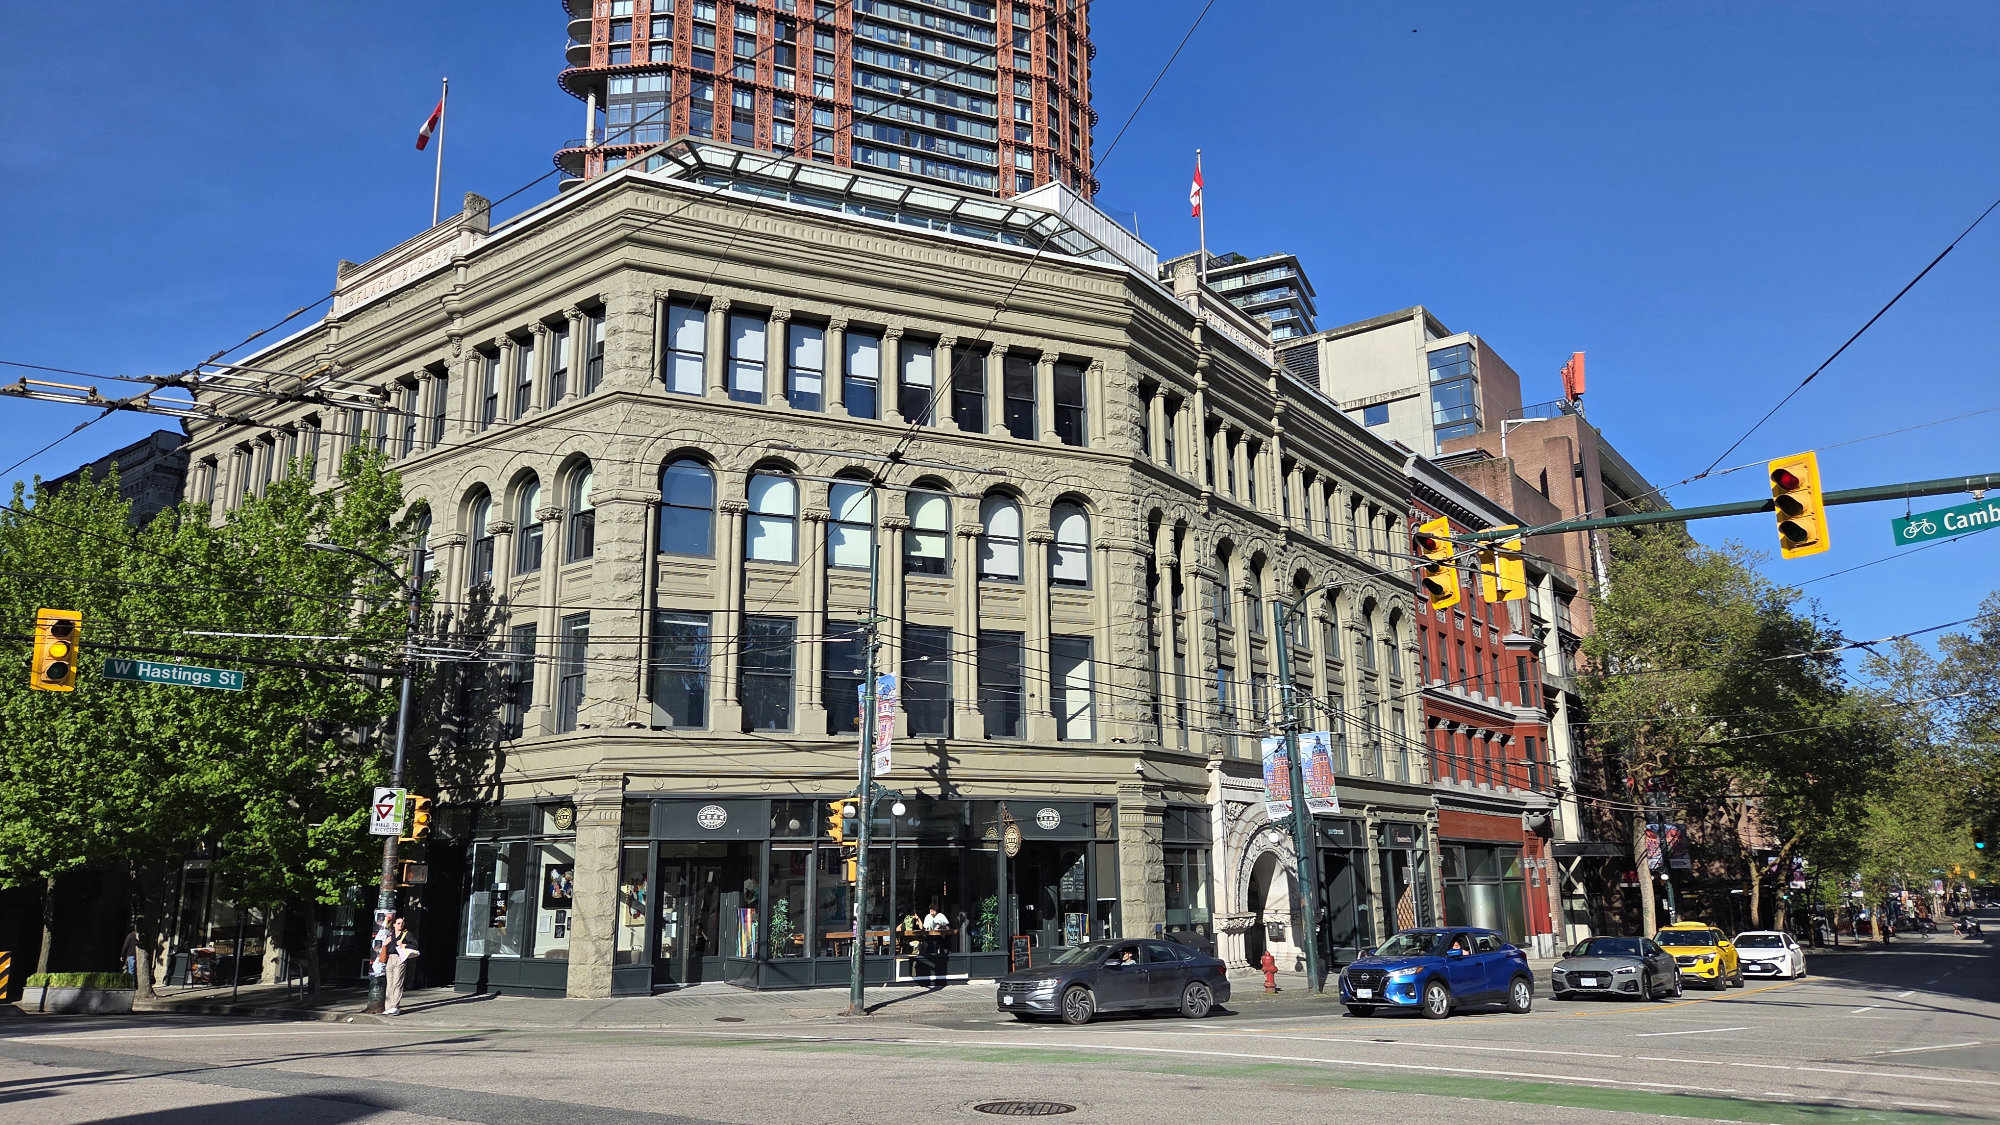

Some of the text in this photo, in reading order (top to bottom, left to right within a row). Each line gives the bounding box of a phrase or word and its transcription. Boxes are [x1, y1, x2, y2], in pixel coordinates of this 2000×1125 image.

[355, 275, 393, 303] FLACK
[402, 251, 441, 280] BLOCK
[1943, 504, 2000, 531] Camb
[114, 661, 237, 686] W Hastings St
